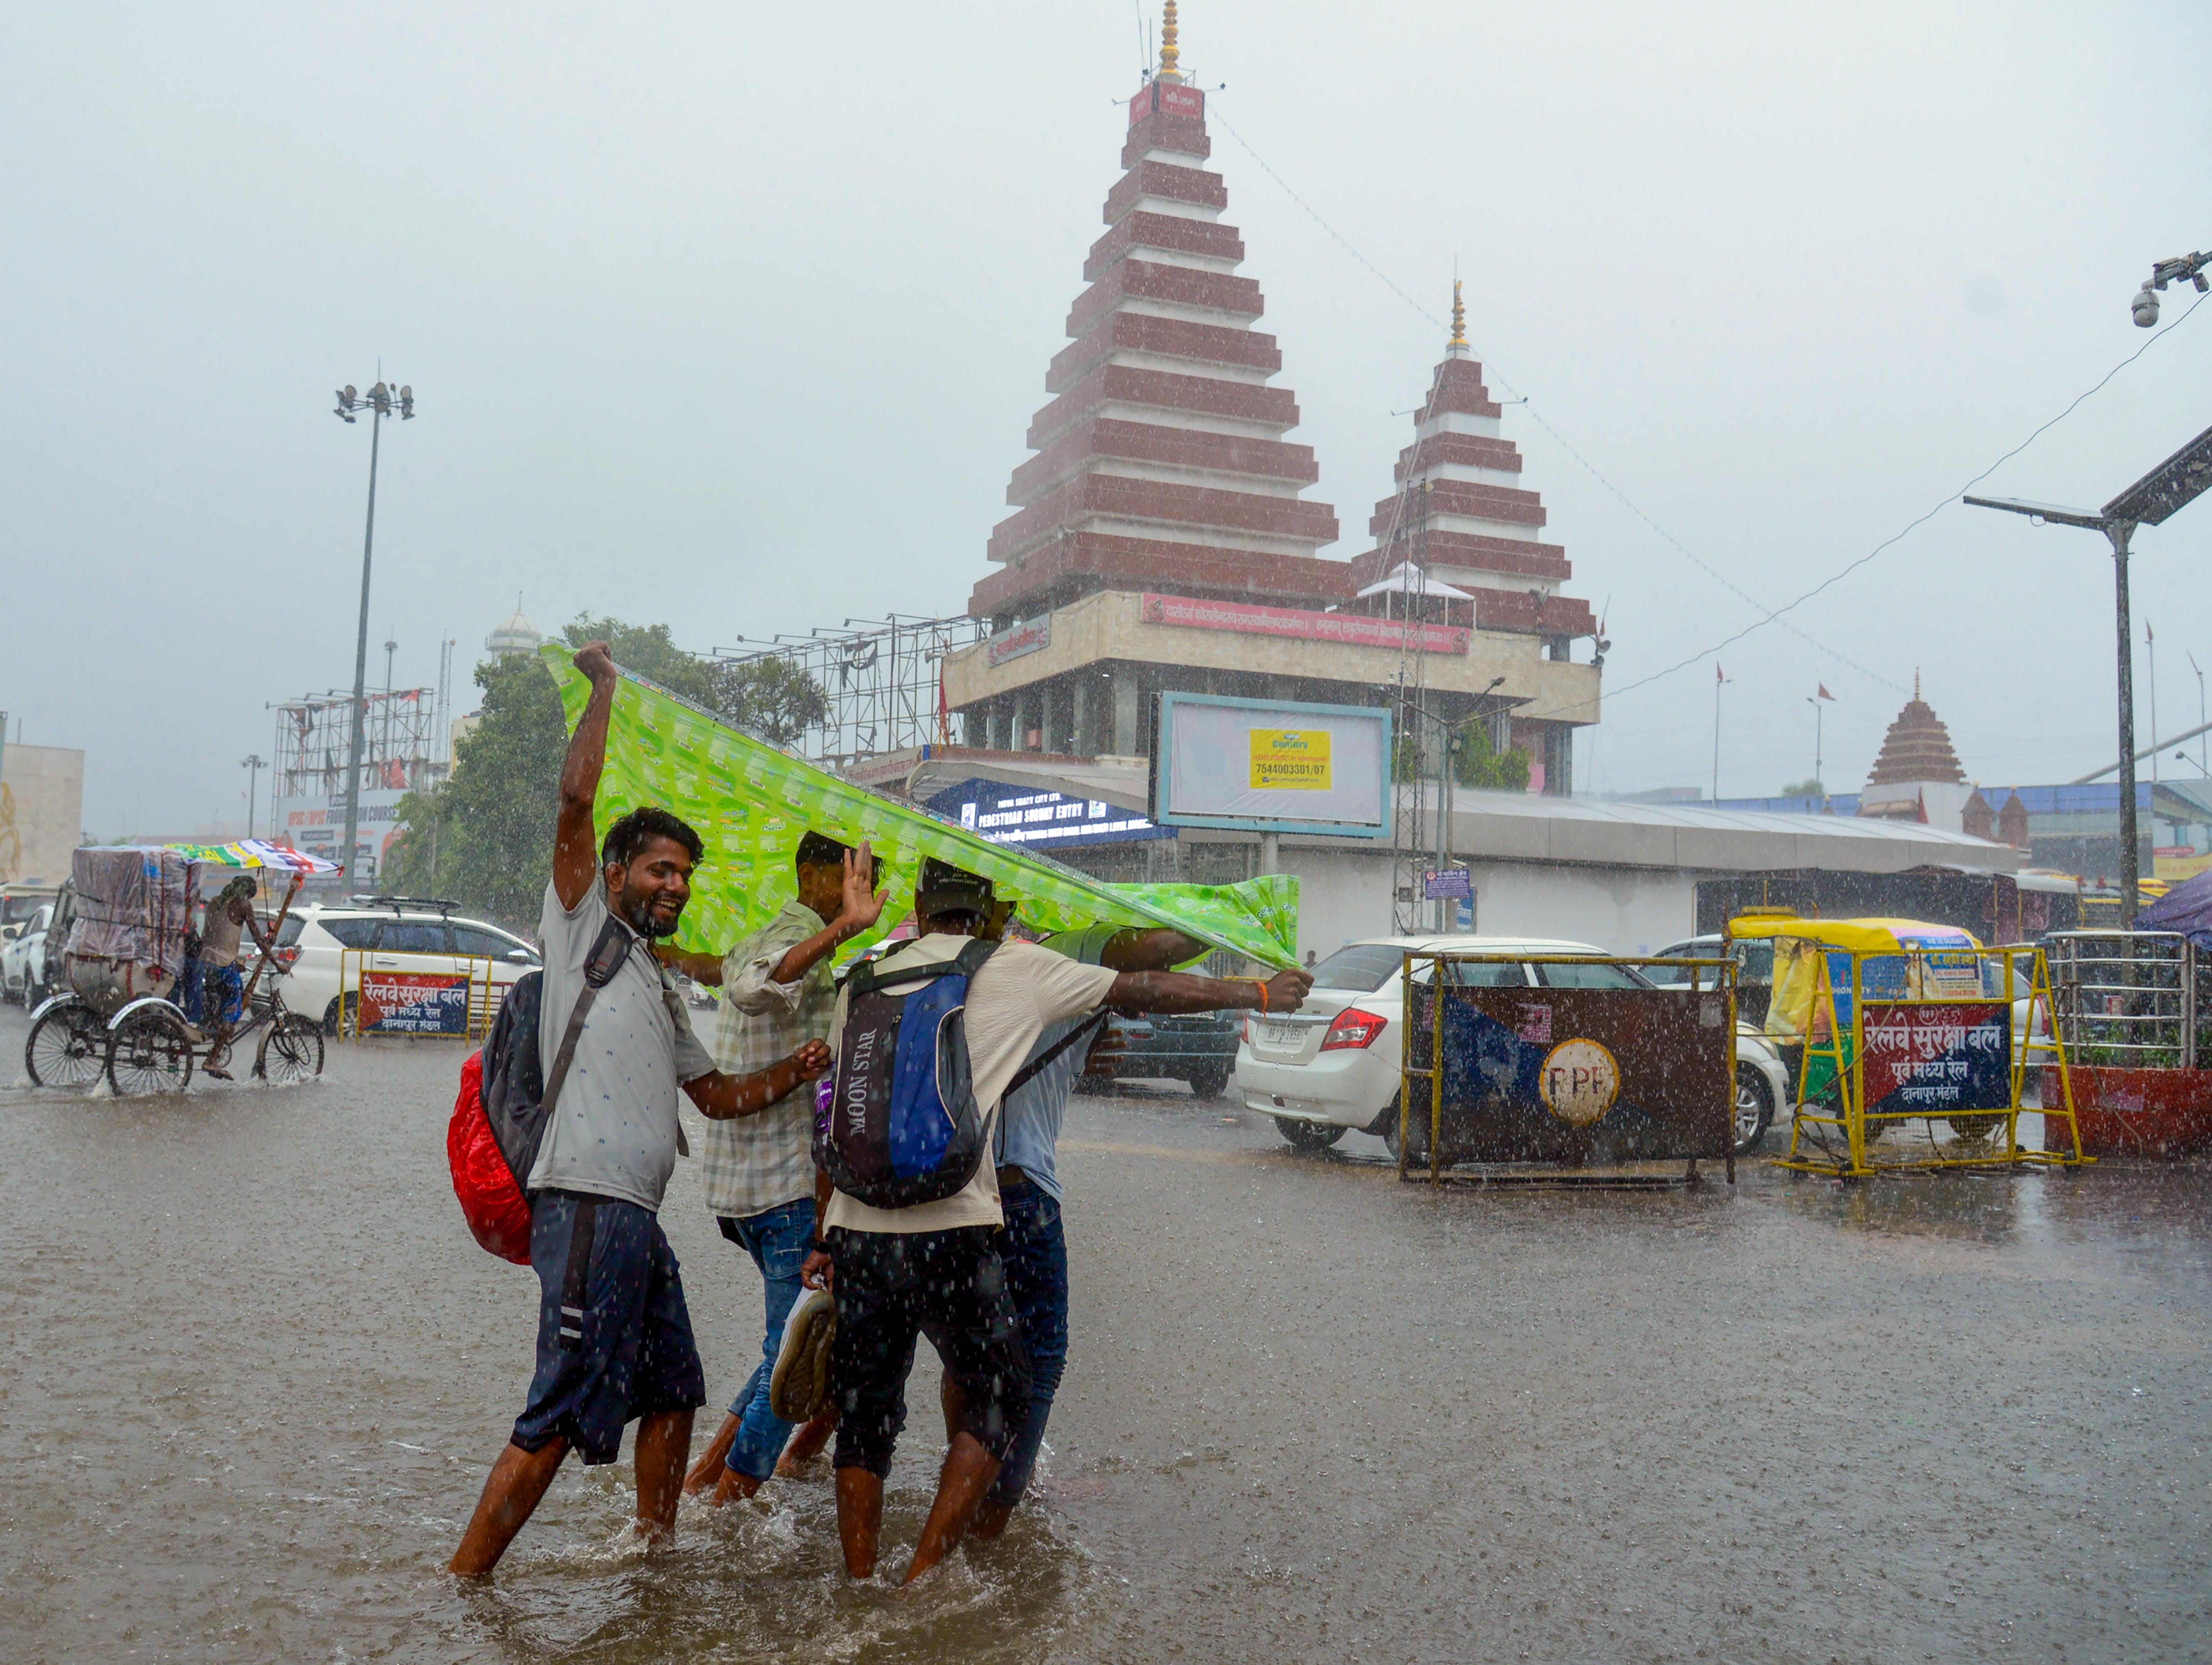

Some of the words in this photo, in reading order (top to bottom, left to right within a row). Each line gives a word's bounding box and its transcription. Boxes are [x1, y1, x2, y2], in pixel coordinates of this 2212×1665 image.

[1272, 740, 1308, 749] Century
[1256, 764, 1325, 775] 7544003301/07
[1035, 793, 1048, 804] CITY
[978, 811, 1023, 827] PEDESTRIAN
[1024, 806, 1054, 823] SUBWAY
[1056, 803, 1083, 819] ENTRY
[363, 976, 398, 1002] रेलवे
[399, 986, 439, 1007] सुरक्षा
[440, 988, 466, 1005] बल
[379, 1003, 396, 1018] पूर्व
[399, 1006, 422, 1017] मध्य
[425, 1005, 441, 1018] रेल
[382, 1019, 418, 1031] दानापुर
[1863, 1011, 1911, 1054] रेलवे
[1913, 1025, 1966, 1059] सुरक्षा
[1967, 1025, 2001, 1053] बल
[852, 1028, 877, 1071] STAR
[1891, 1056, 1911, 1085] पूर्व
[1912, 1061, 1945, 1077] मध्य
[1947, 1057, 1968, 1081] रेल
[847, 1075, 867, 1136] MOON
[1902, 1086, 1935, 1104] दानापुर
